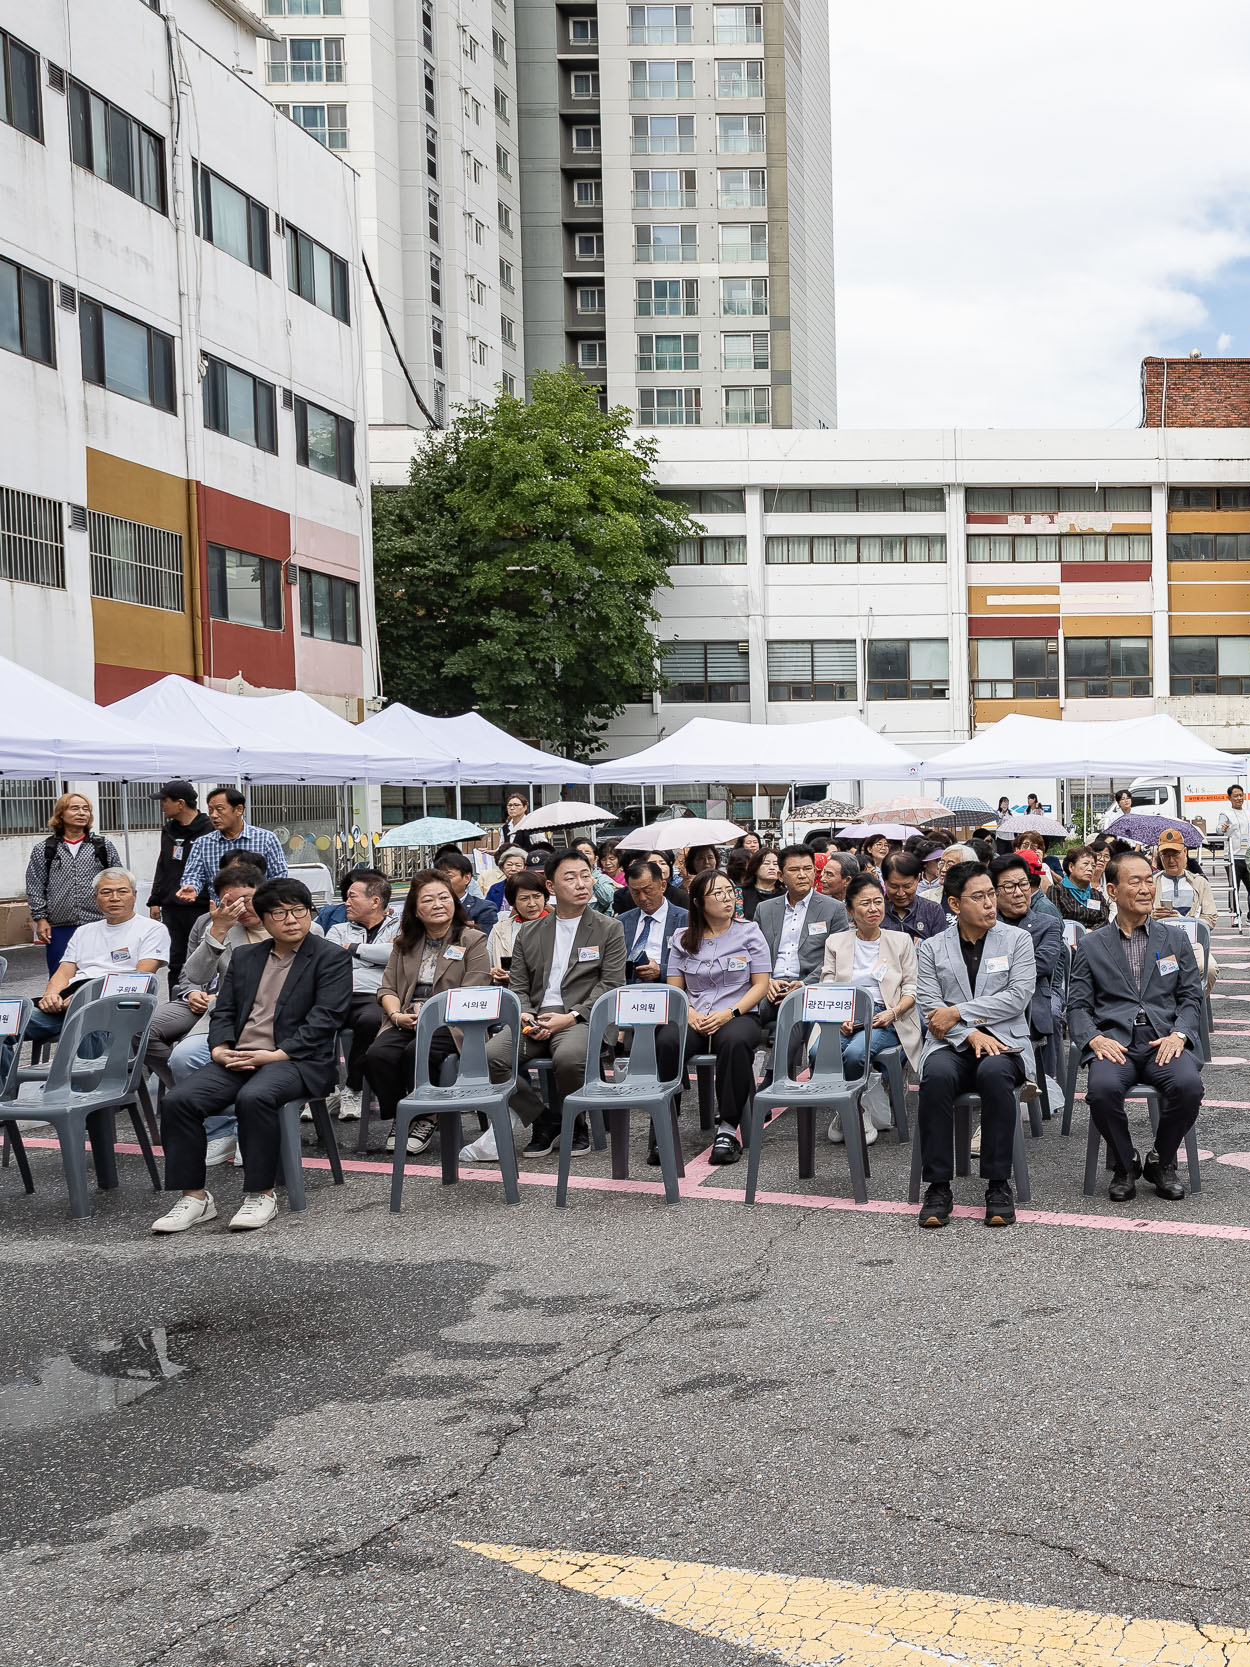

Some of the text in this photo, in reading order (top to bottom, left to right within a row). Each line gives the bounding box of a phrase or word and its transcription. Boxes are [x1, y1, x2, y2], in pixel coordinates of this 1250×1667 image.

[116, 985, 138, 993] 구의원
[462, 1000, 488, 1010] 시의원
[631, 1002, 656, 1013] 시의원
[807, 1000, 852, 1011] 광진구의장
